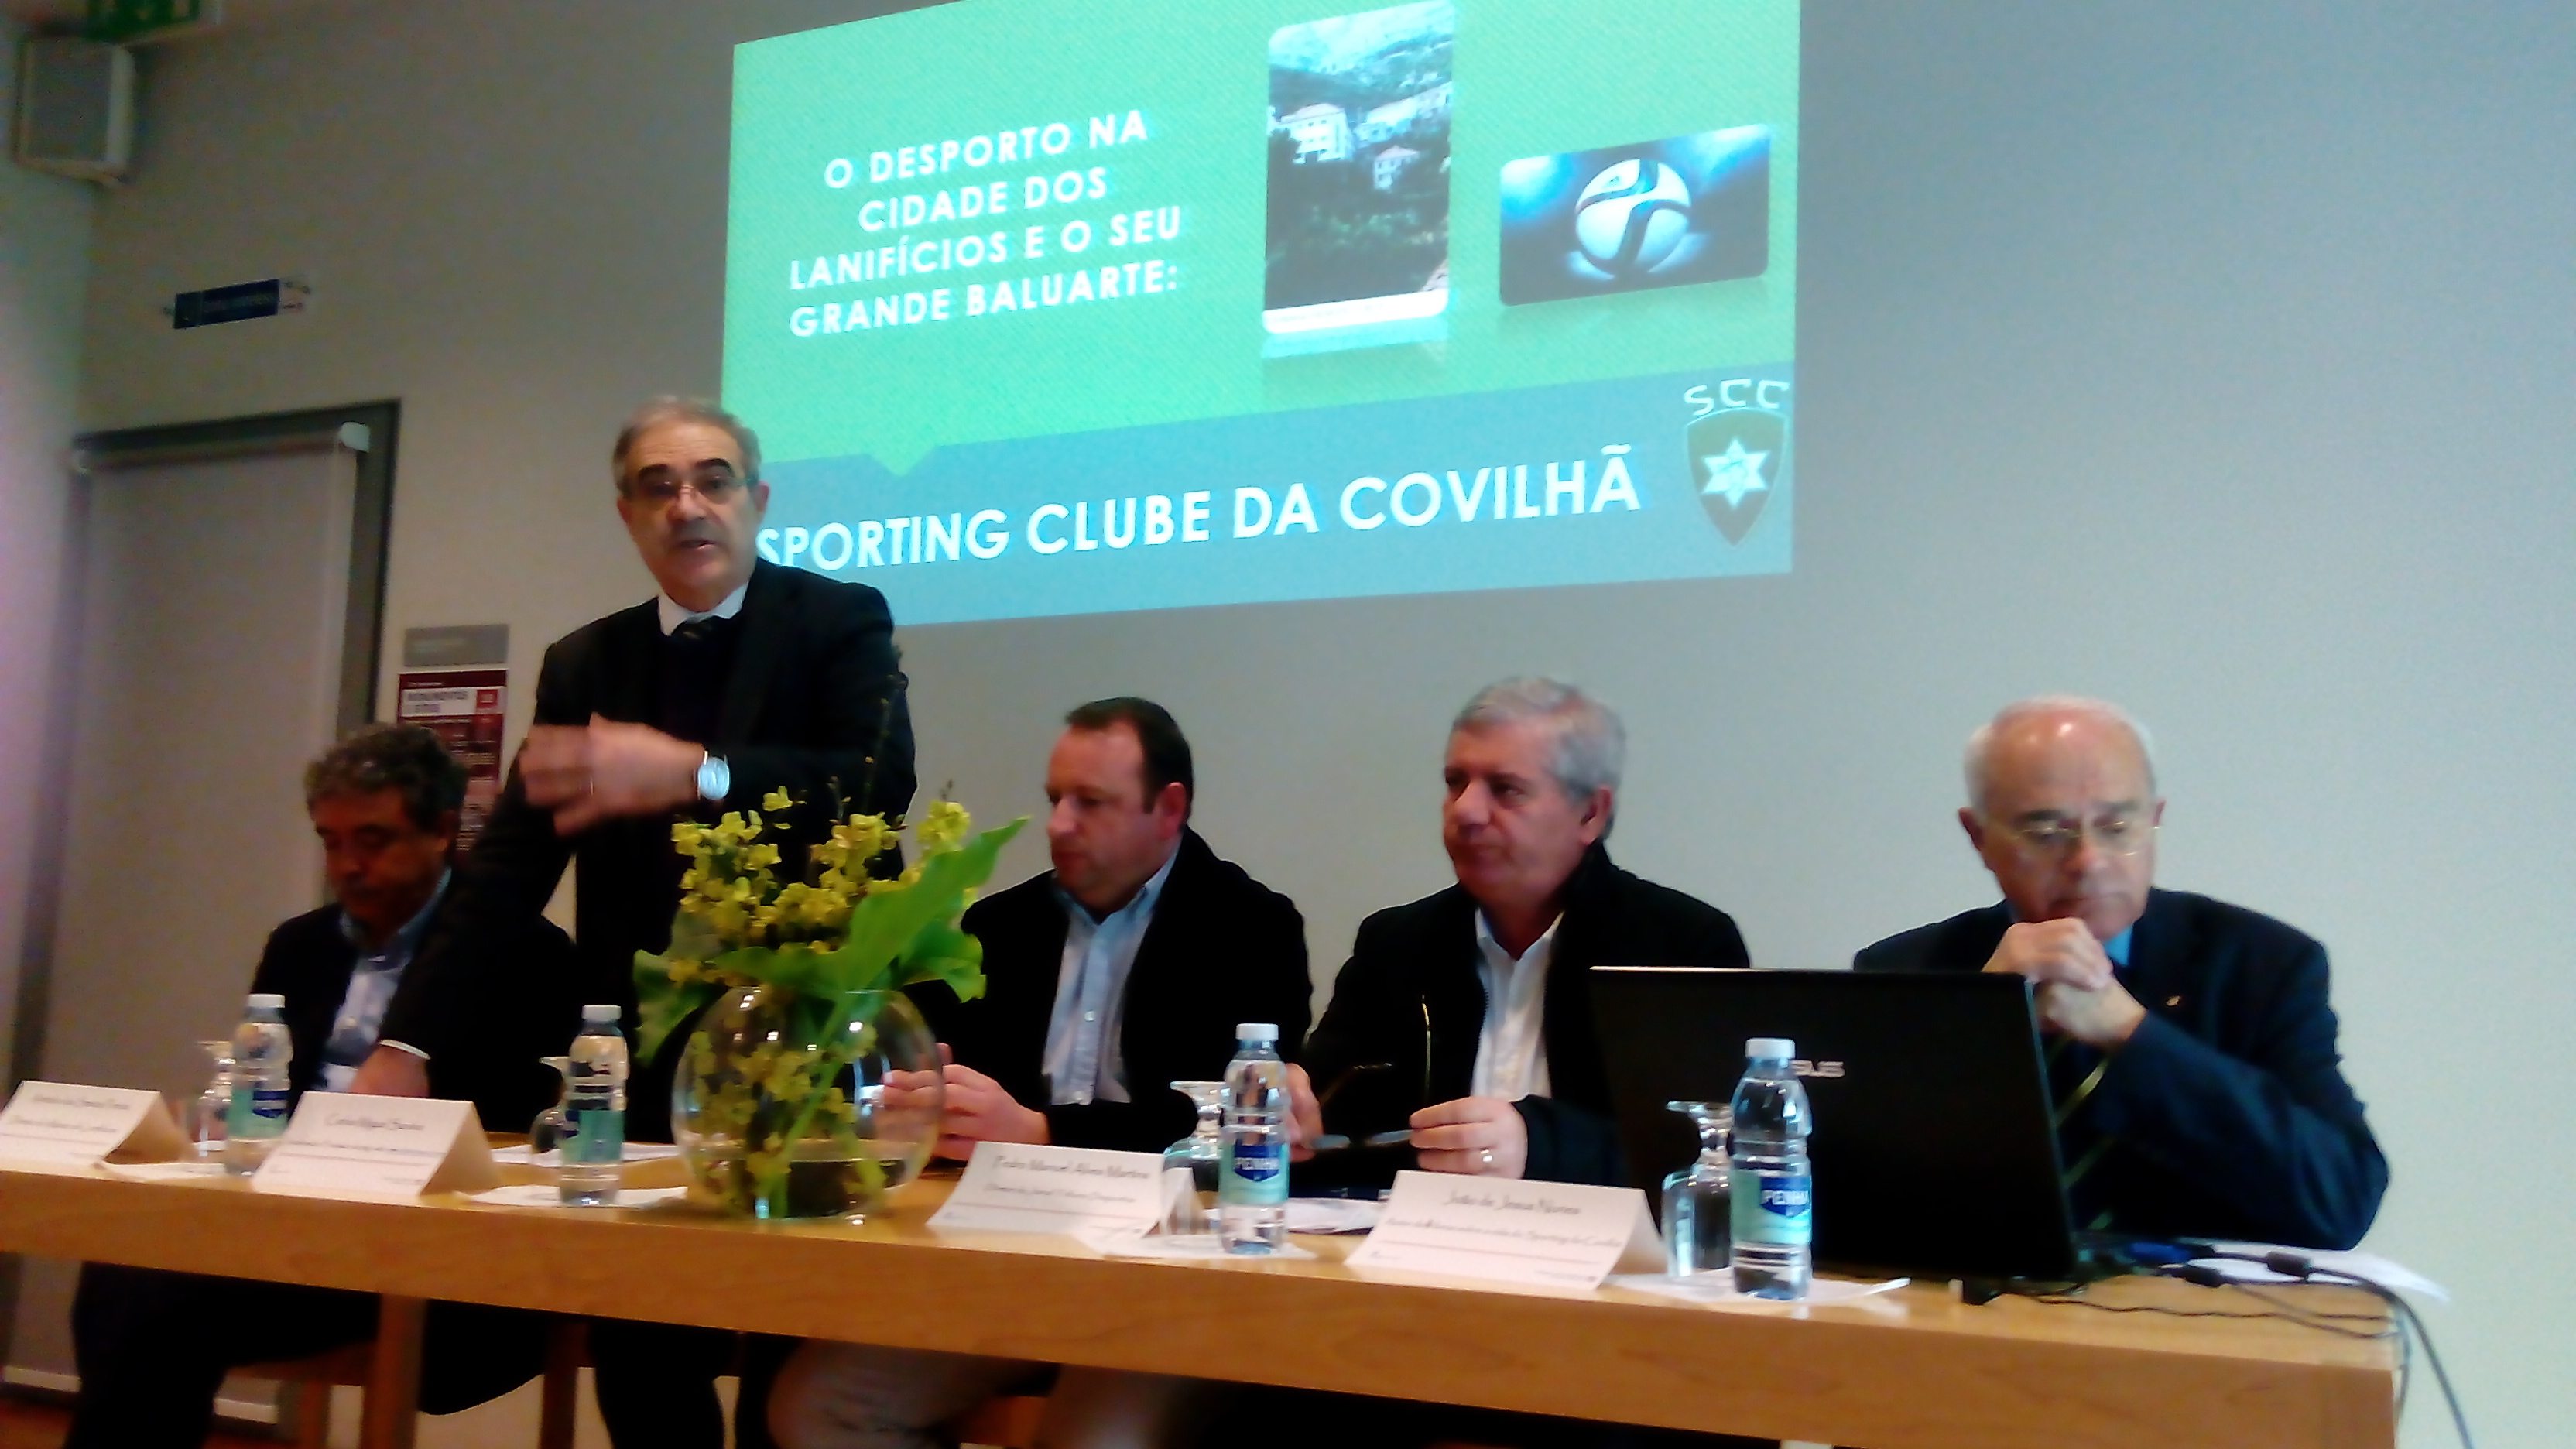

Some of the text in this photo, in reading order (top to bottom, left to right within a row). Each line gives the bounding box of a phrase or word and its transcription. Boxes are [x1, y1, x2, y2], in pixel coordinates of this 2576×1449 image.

[824, 109, 1149, 189] O DESPORTO NA
[858, 166, 1107, 232] CIDADE DOS
[790, 205, 1181, 290] LANIFÍCIOS E O SEU
[789, 259, 1178, 337] GRANDE BALUARTE:
[1684, 378, 1790, 416] SCC
[755, 444, 1641, 571] SPORTING CLUBE DA COVILHÃ
